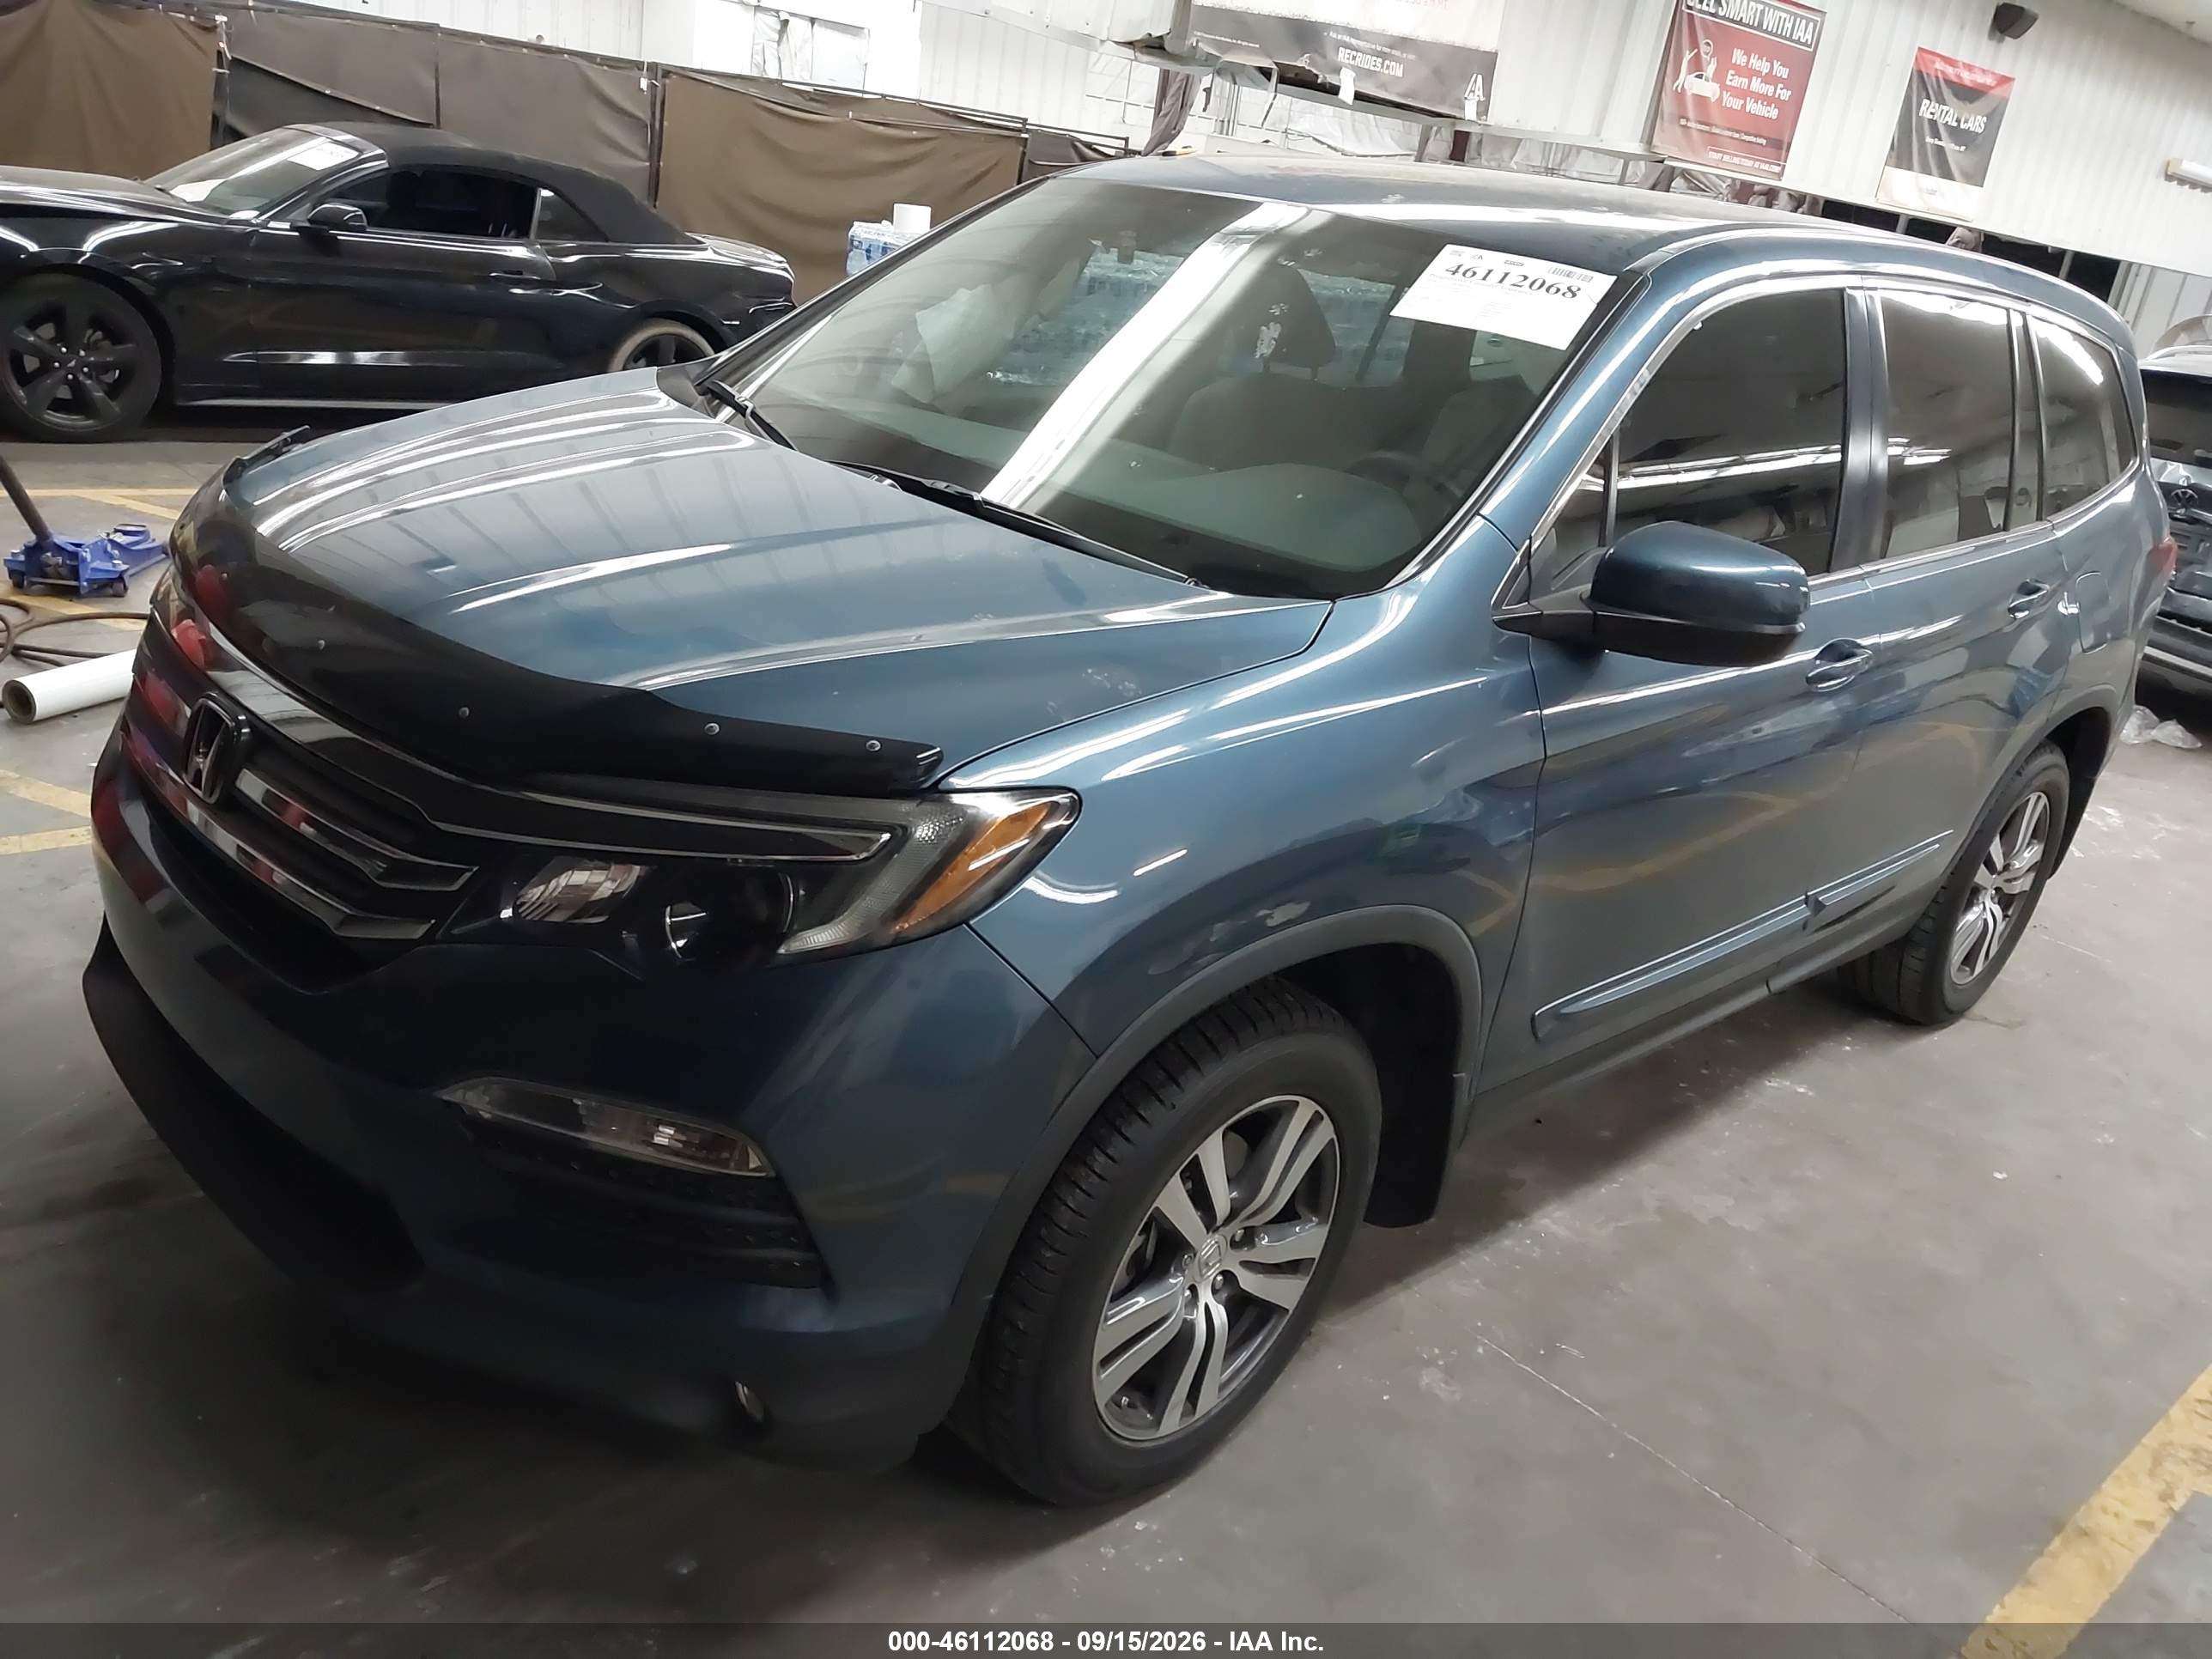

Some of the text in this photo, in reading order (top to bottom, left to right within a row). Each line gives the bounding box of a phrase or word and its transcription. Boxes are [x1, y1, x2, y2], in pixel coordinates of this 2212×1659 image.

[1718, 0, 1764, 27] SMART
[1762, 7, 1795, 39] WITH
[1791, 17, 1815, 45] IAA
[1338, 46, 1404, 77] RECRIDES.COM
[1731, 47, 1790, 79] We Help You
[1726, 70, 1792, 101] Earn More For
[1721, 90, 1779, 120] Your Vehicle
[1918, 99, 1988, 134] RENTAL CARS
[1445, 263, 1583, 300] 46112068
